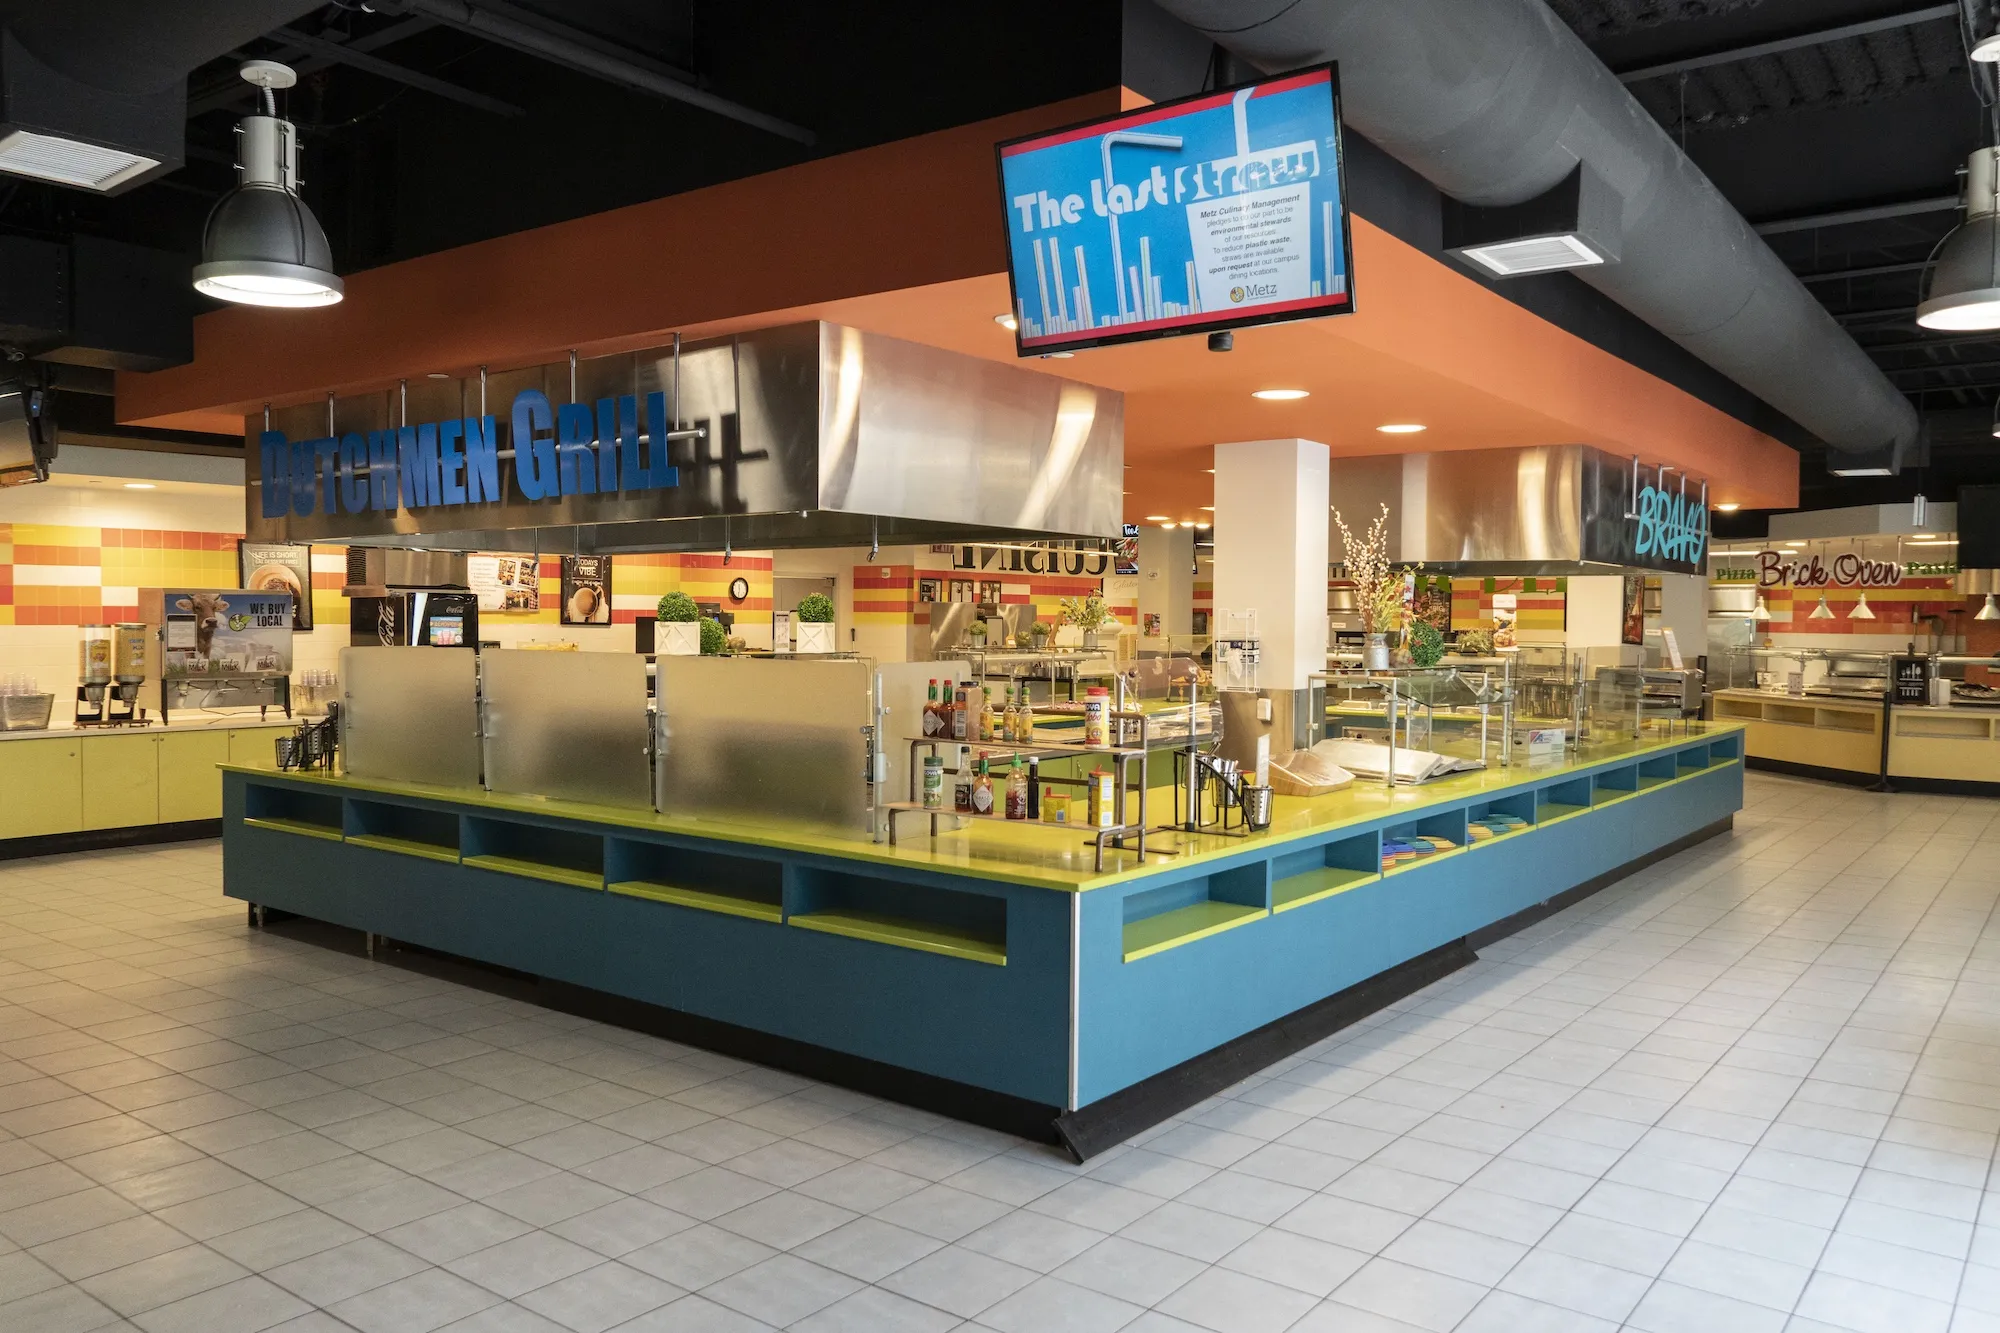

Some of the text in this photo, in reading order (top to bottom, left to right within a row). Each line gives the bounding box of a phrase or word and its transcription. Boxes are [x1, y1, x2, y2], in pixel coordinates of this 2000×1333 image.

[1012, 148, 1316, 233] The Last Straw
[1200, 194, 1301, 219] Metz Culinary Management
[1206, 217, 1232, 228] pledges
[1250, 211, 1261, 219] our
[1262, 208, 1275, 218] part
[1284, 205, 1293, 213] be
[1210, 216, 1292, 236] environmental stewards
[1221, 243, 1244, 252] reduce
[1245, 240, 1268, 250] plastic
[1224, 235, 1231, 243] of
[1221, 254, 1242, 262] straws
[1255, 247, 1284, 257] available
[1208, 265, 1226, 275] upon
[1227, 261, 1253, 272] request
[1273, 254, 1300, 265] campus
[1228, 273, 1248, 281] dining
[1246, 284, 1277, 297] Metz
[1634, 485, 1706, 565] BRAVO
[1716, 567, 1756, 580] Pizza
[1755, 550, 1902, 587] Brick Oven
[249, 603, 265, 614] WE
[268, 603, 286, 614] BUY
[257, 615, 283, 627] LOCAL
